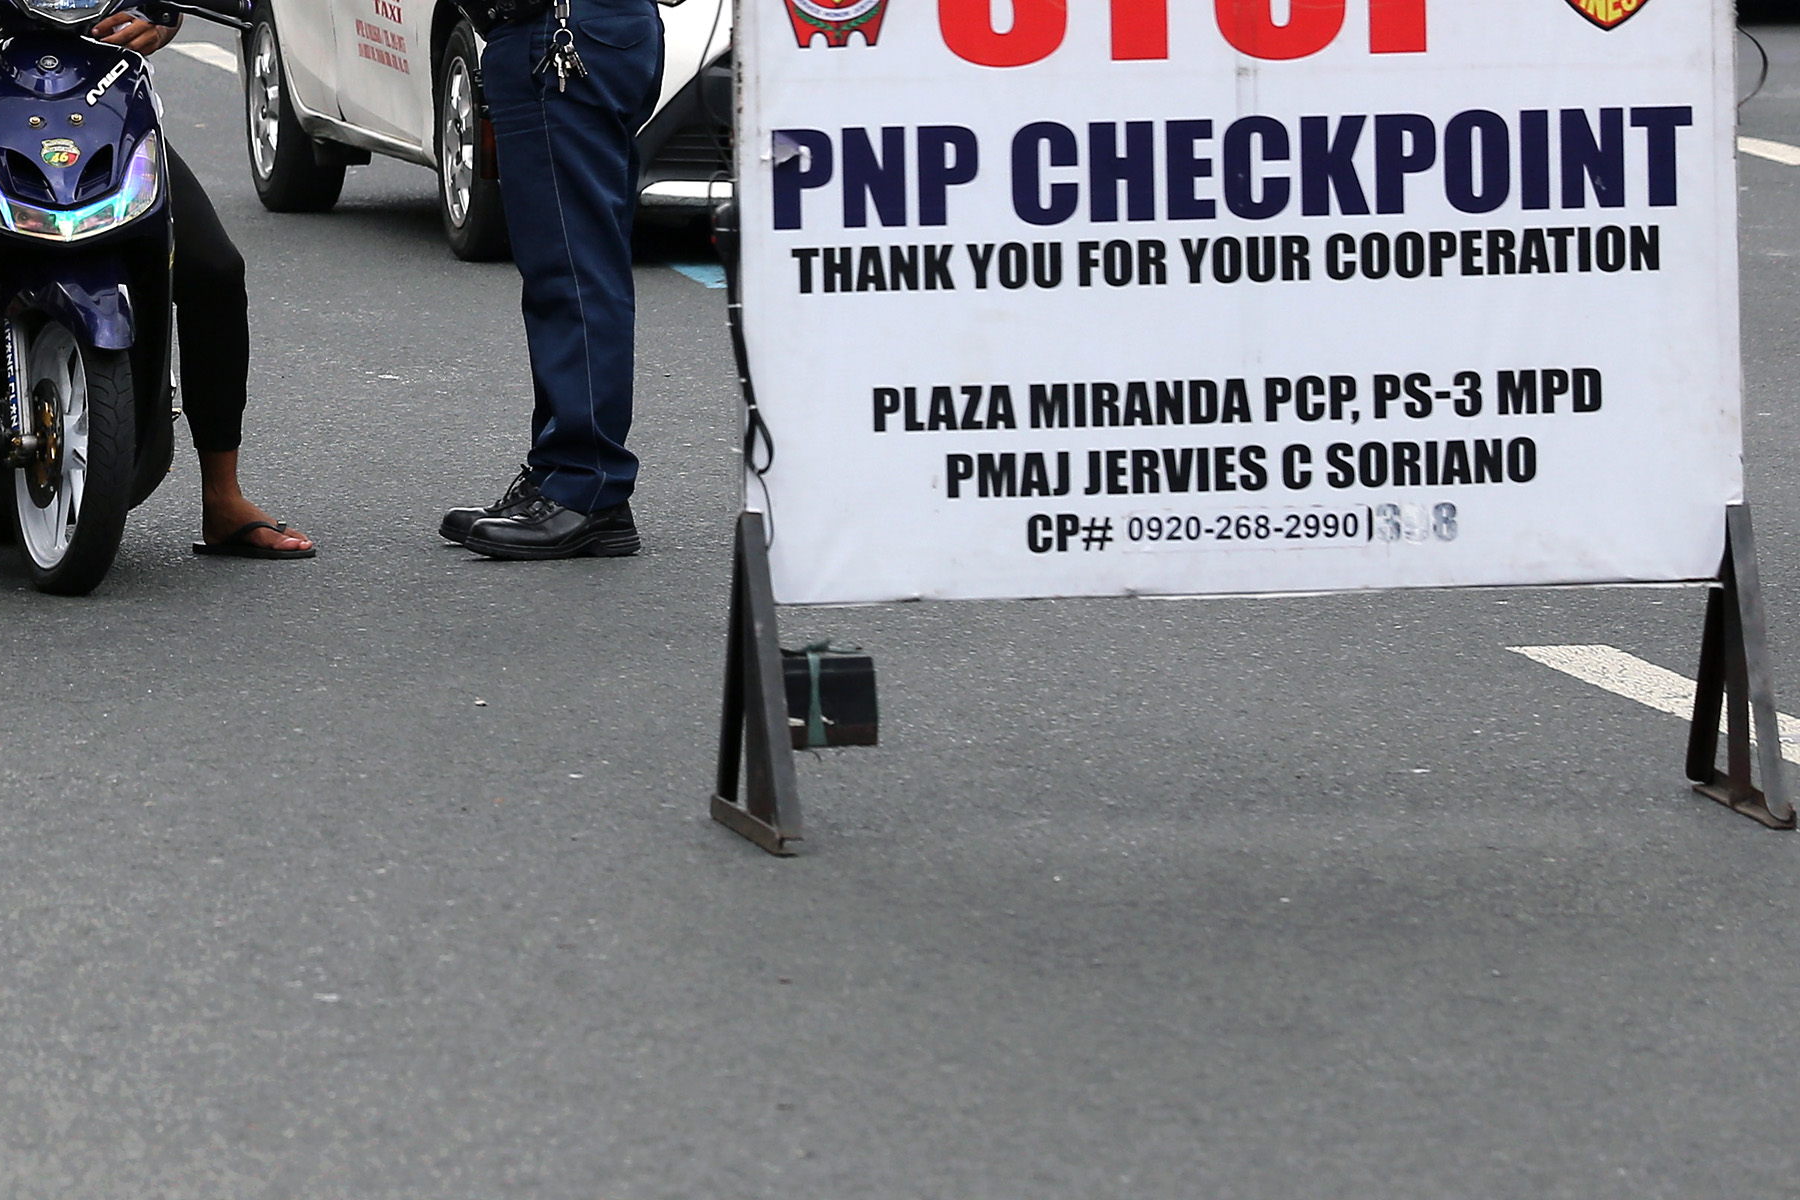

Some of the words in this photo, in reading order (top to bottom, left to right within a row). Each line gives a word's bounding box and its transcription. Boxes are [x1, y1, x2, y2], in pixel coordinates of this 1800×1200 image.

[50, 152, 69, 164] 46
[772, 124, 978, 231] PNP
[1012, 105, 1692, 226] CHECKPOINT
[792, 244, 954, 294] THANK
[967, 241, 1061, 290] YOU
[1079, 239, 1166, 287] FOR
[1183, 235, 1310, 284] YOUR
[1326, 224, 1660, 281] COOPERATION
[873, 384, 1016, 433] PLAZA
[1029, 378, 1251, 429] MIRANDA
[1265, 375, 1361, 428] PCP,
[1374, 371, 1482, 420] PS-3
[1498, 367, 1602, 416] MPD
[947, 451, 1069, 499] PMAJ
[1085, 444, 1268, 496] JERVIES
[1283, 443, 1312, 490] C
[1327, 436, 1537, 489] SORIANO
[1028, 514, 1114, 553] CP#
[1128, 512, 1359, 542] 0920-268-2990
